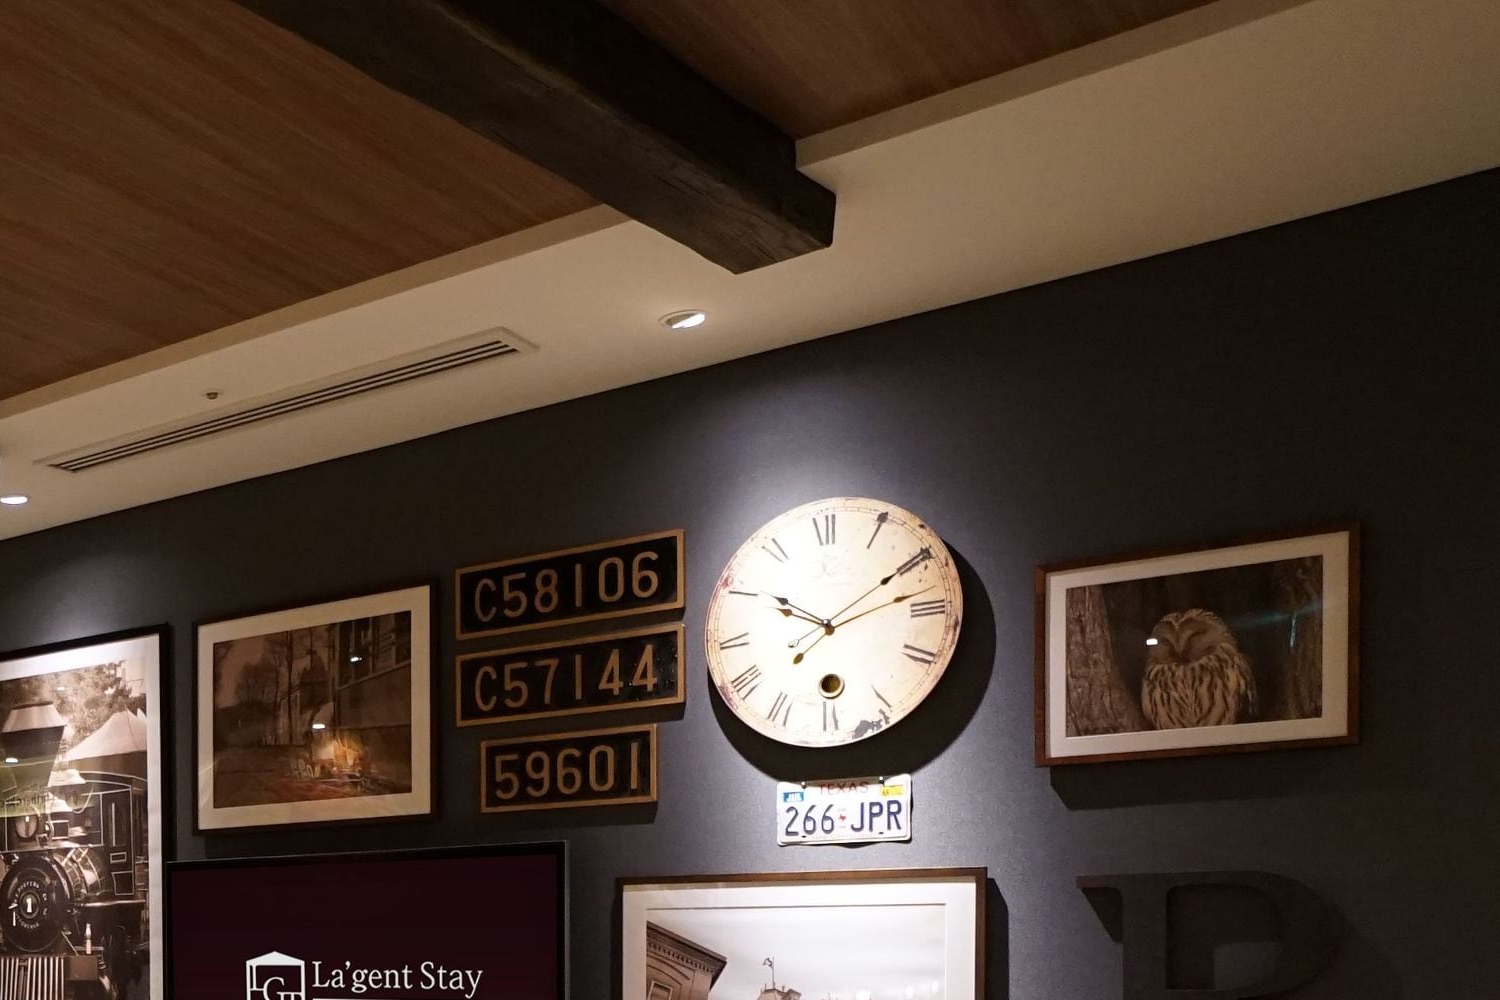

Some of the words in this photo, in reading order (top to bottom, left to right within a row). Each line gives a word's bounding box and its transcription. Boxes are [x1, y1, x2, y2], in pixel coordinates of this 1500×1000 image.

[474, 551, 659, 622] C58106
[474, 644, 658, 711] C57144
[494, 742, 639, 800] 59601
[819, 781, 870, 796] TEXAS
[784, 804, 835, 837] 266
[850, 799, 902, 833] JPR
[419, 961, 484, 999] Stay
